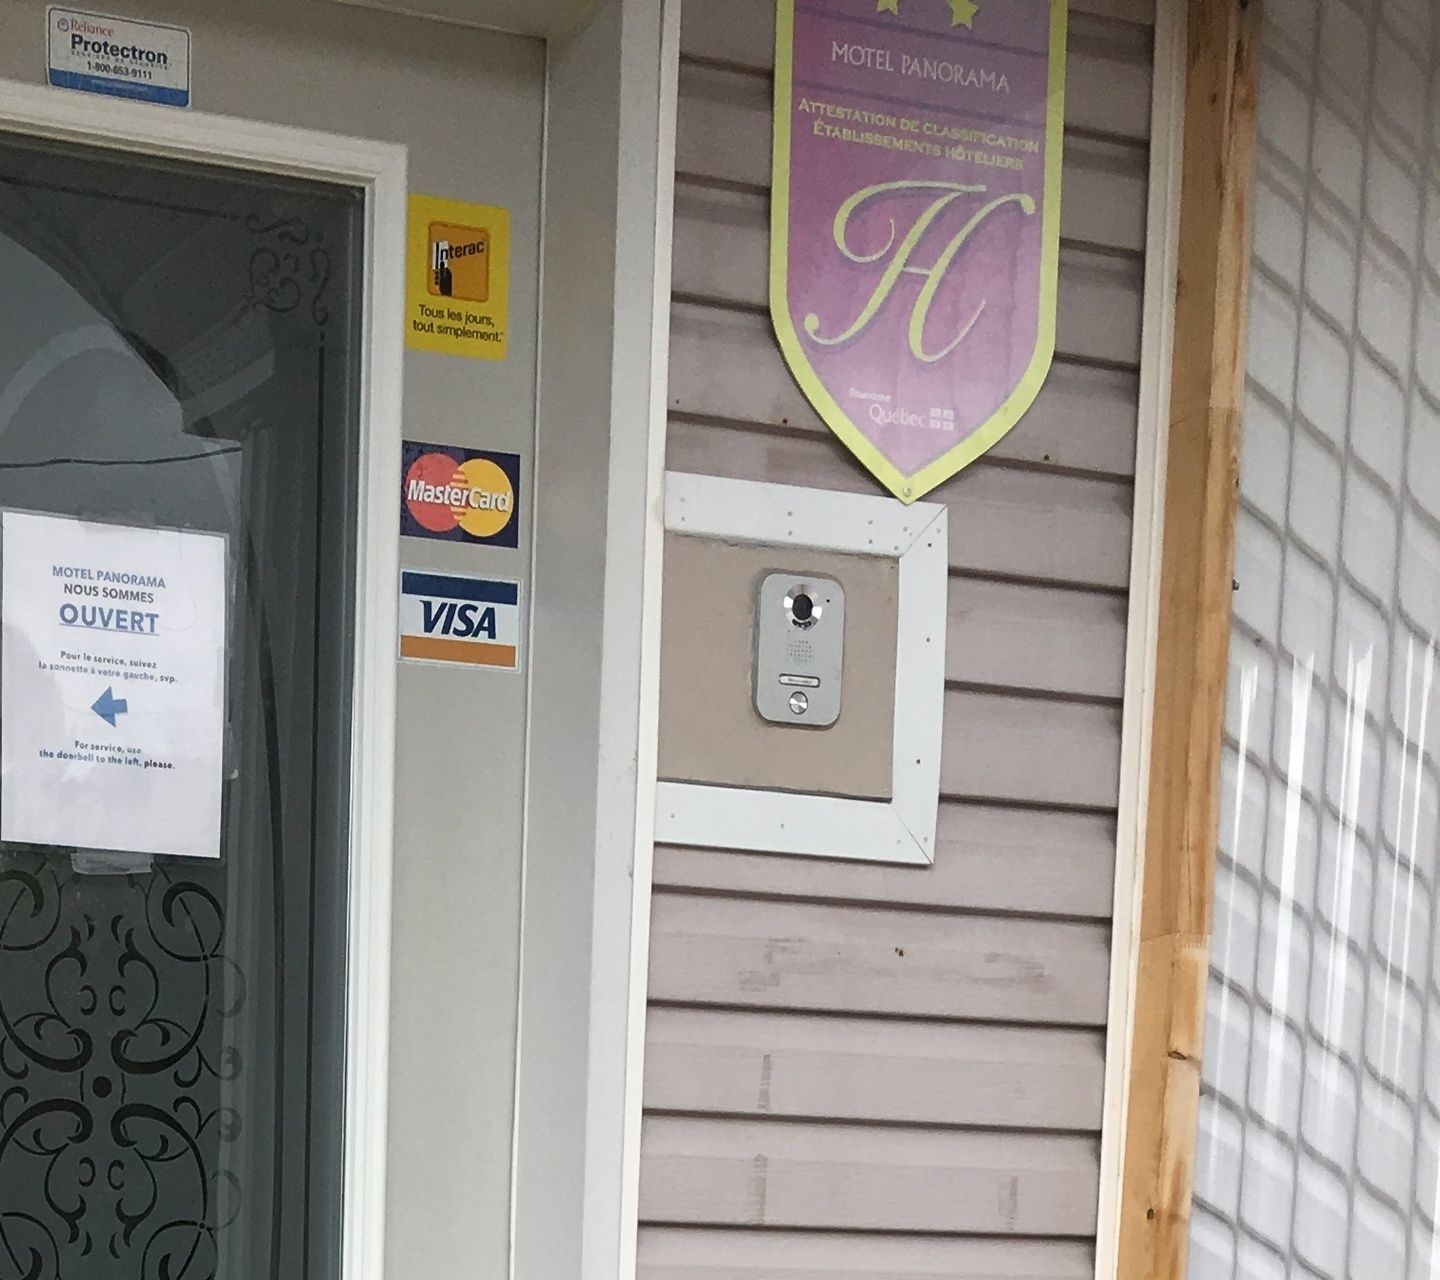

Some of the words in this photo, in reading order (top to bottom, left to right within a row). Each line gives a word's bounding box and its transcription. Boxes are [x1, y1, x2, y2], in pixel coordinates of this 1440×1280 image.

[71, 18, 113, 37] Reliance
[71, 33, 168, 64] Protectron
[87, 60, 152, 79] 1-800-653-9111
[832, 42, 894, 72] MOTEL
[902, 54, 1010, 92] PANORAMA
[798, 98, 897, 128] ATTESTATION
[900, 118, 920, 133] DE
[923, 122, 1039, 153] CLASSIFICATION
[435, 240, 485, 265] Interac
[804, 180, 1036, 363] H
[413, 319, 434, 333] tout
[419, 304, 445, 318] Tous
[447, 308, 462, 321] les
[465, 311, 495, 327] jours,
[869, 403, 928, 427] Québec
[407, 479, 510, 513] MasterCard
[52, 565, 94, 580] MOTEL
[97, 570, 166, 589] PANORAMA
[64, 583, 99, 597] NOUS
[102, 587, 154, 603] SOMMES
[59, 603, 160, 634] OUVERT
[418, 600, 496, 640] VISA
[39, 661, 47, 669] la
[49, 663, 88, 673] sonnette
[97, 668, 120, 677] votre
[60, 650, 81, 661] Pour
[83, 653, 91, 661] le
[94, 656, 127, 667] service,
[129, 660, 157, 669] suivez
[39, 749, 54, 758] the
[57, 750, 94, 762] doorbell
[96, 755, 105, 763] to
[108, 756, 122, 765] the
[75, 740, 88, 750] For
